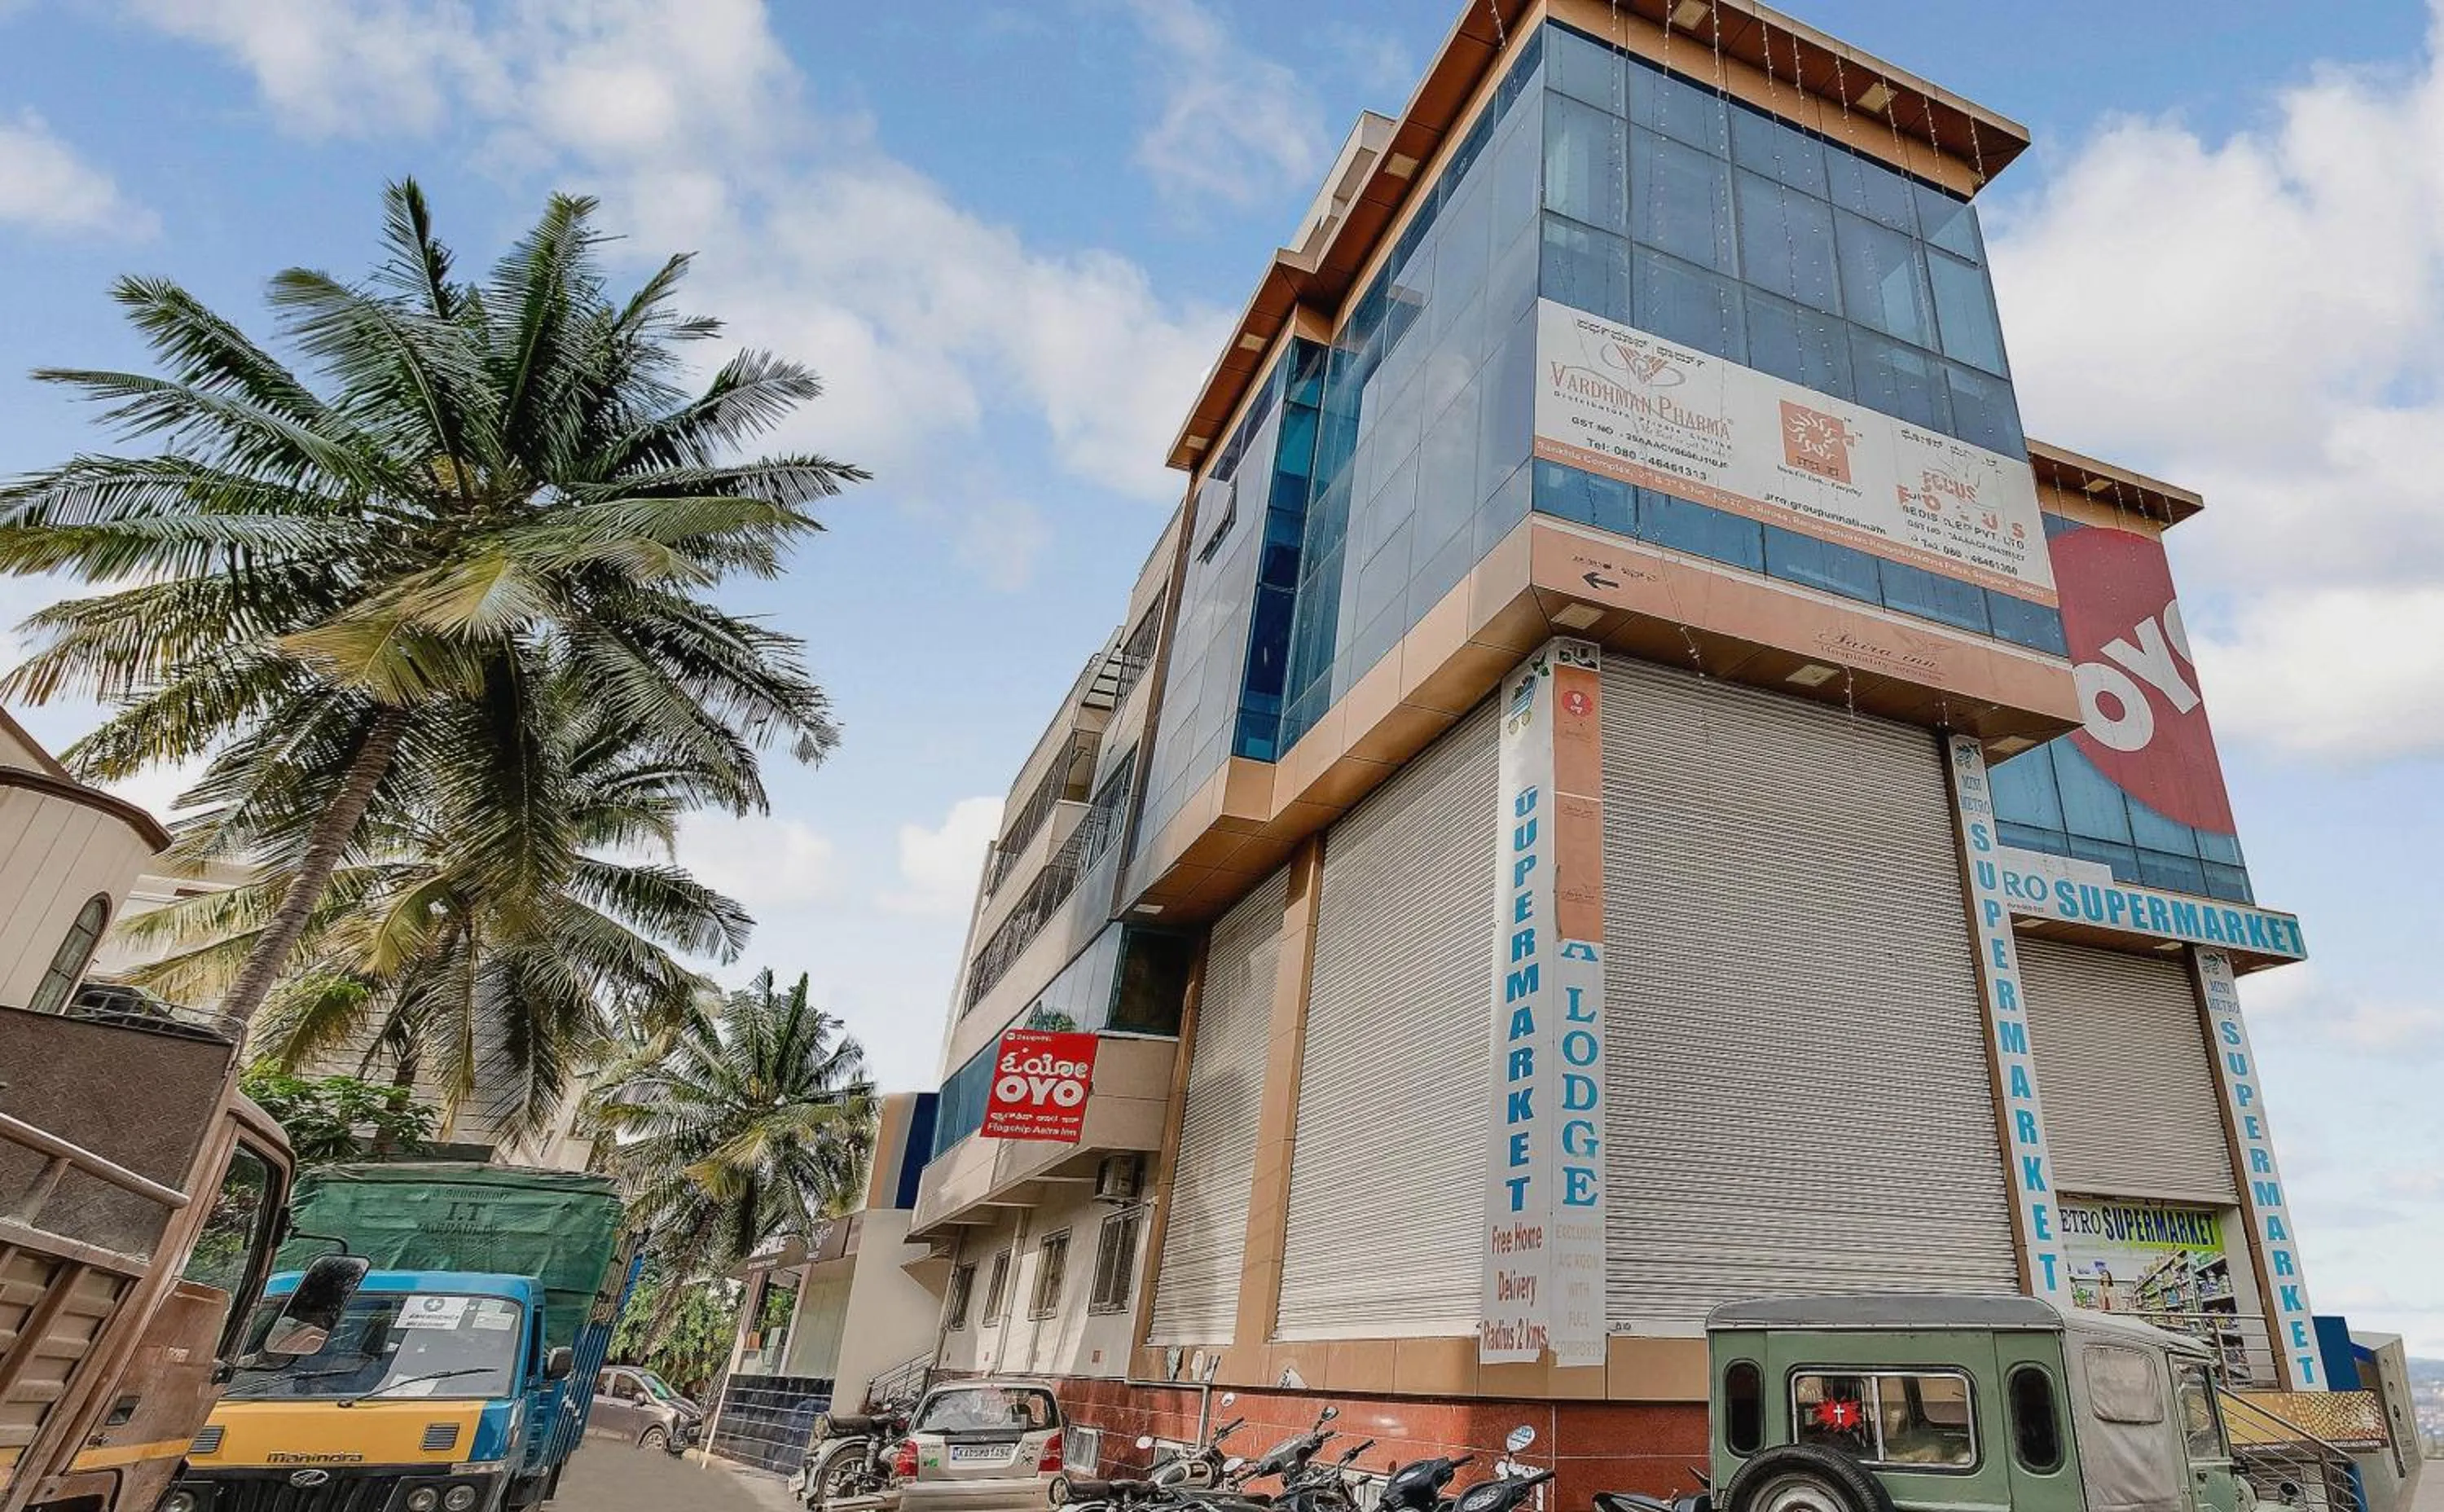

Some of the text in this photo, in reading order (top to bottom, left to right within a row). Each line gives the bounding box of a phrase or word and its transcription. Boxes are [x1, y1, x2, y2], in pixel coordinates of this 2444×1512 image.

[1587, 438, 1607, 452] Tel:
[1615, 446, 1636, 460] 080
[2054, 879, 2302, 955] SUPERMARKET
[996, 1075, 1084, 1107] OYO
[1563, 987, 1598, 1207] LODGE
[987, 1122, 1031, 1134] Flagship
[1492, 1222, 1543, 1255] Free Home
[2059, 1206, 2216, 1246] ETRO SUPERMARKET
[1497, 1270, 1537, 1307] Delivery
[1483, 1317, 1548, 1351] Radius 2 kms
